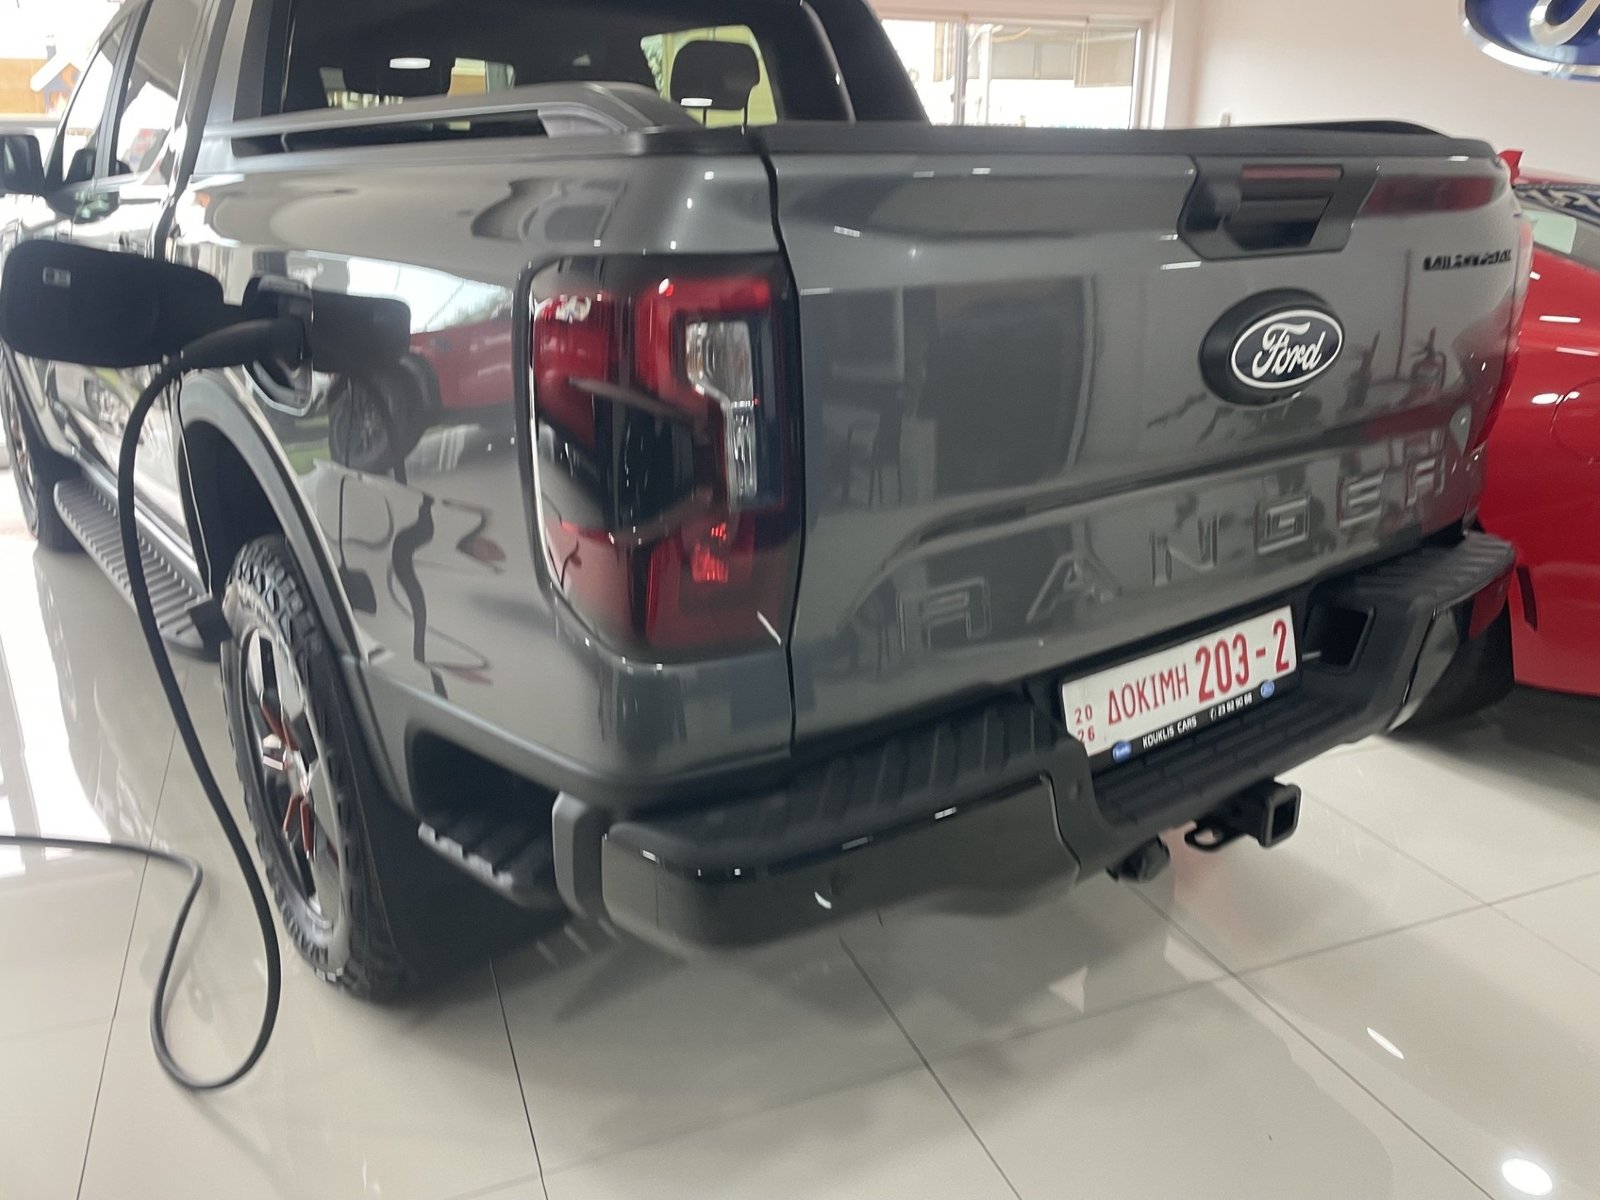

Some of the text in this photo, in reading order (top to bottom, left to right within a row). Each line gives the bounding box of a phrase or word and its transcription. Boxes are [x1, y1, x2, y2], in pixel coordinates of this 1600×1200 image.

[1252, 321, 1326, 378] Ford
[1108, 663, 1189, 726] ΔΟΚΙΜΗ
[1142, 715, 1197, 749] KOUKLIS CARS
